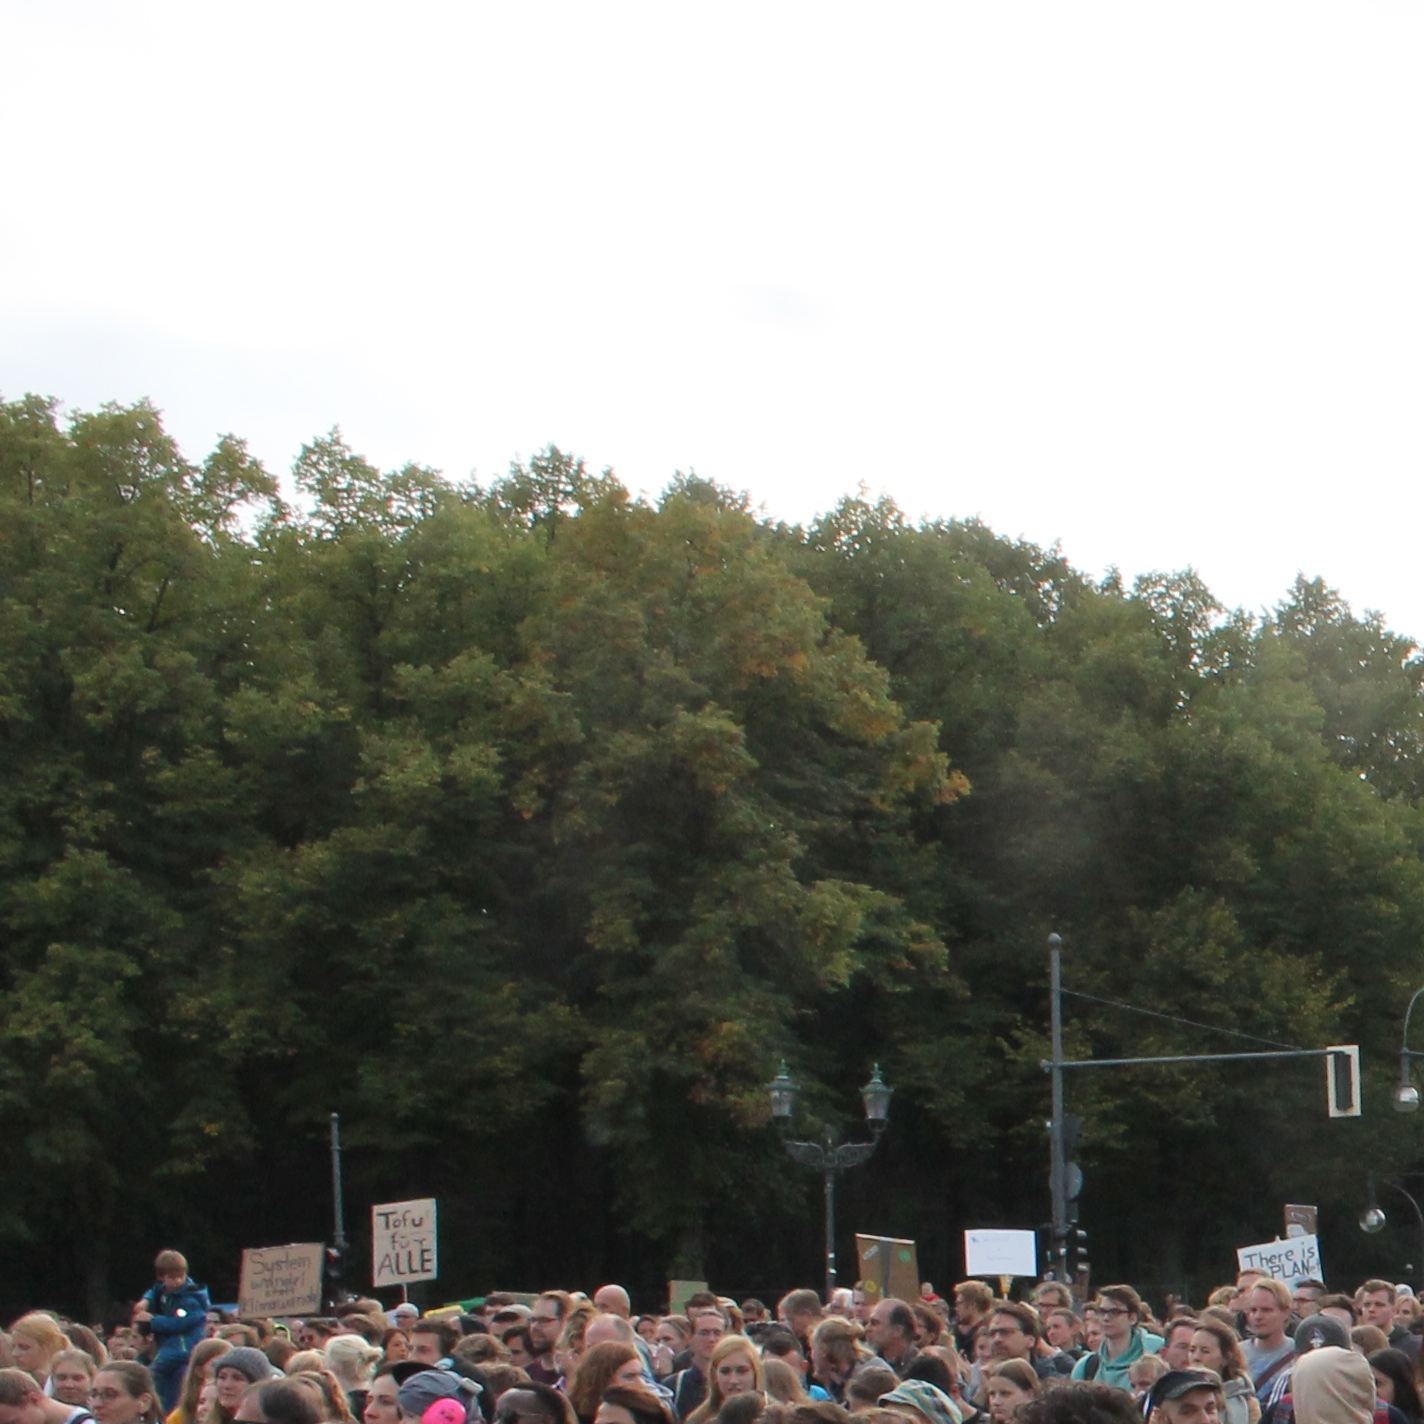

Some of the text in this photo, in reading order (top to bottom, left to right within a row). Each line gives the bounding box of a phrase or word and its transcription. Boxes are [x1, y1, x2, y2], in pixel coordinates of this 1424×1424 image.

[376, 1210, 424, 1231] Tofu
[250, 1250, 311, 1279] System
[377, 1248, 433, 1276] ALLE
[1244, 1241, 1316, 1268] There is
